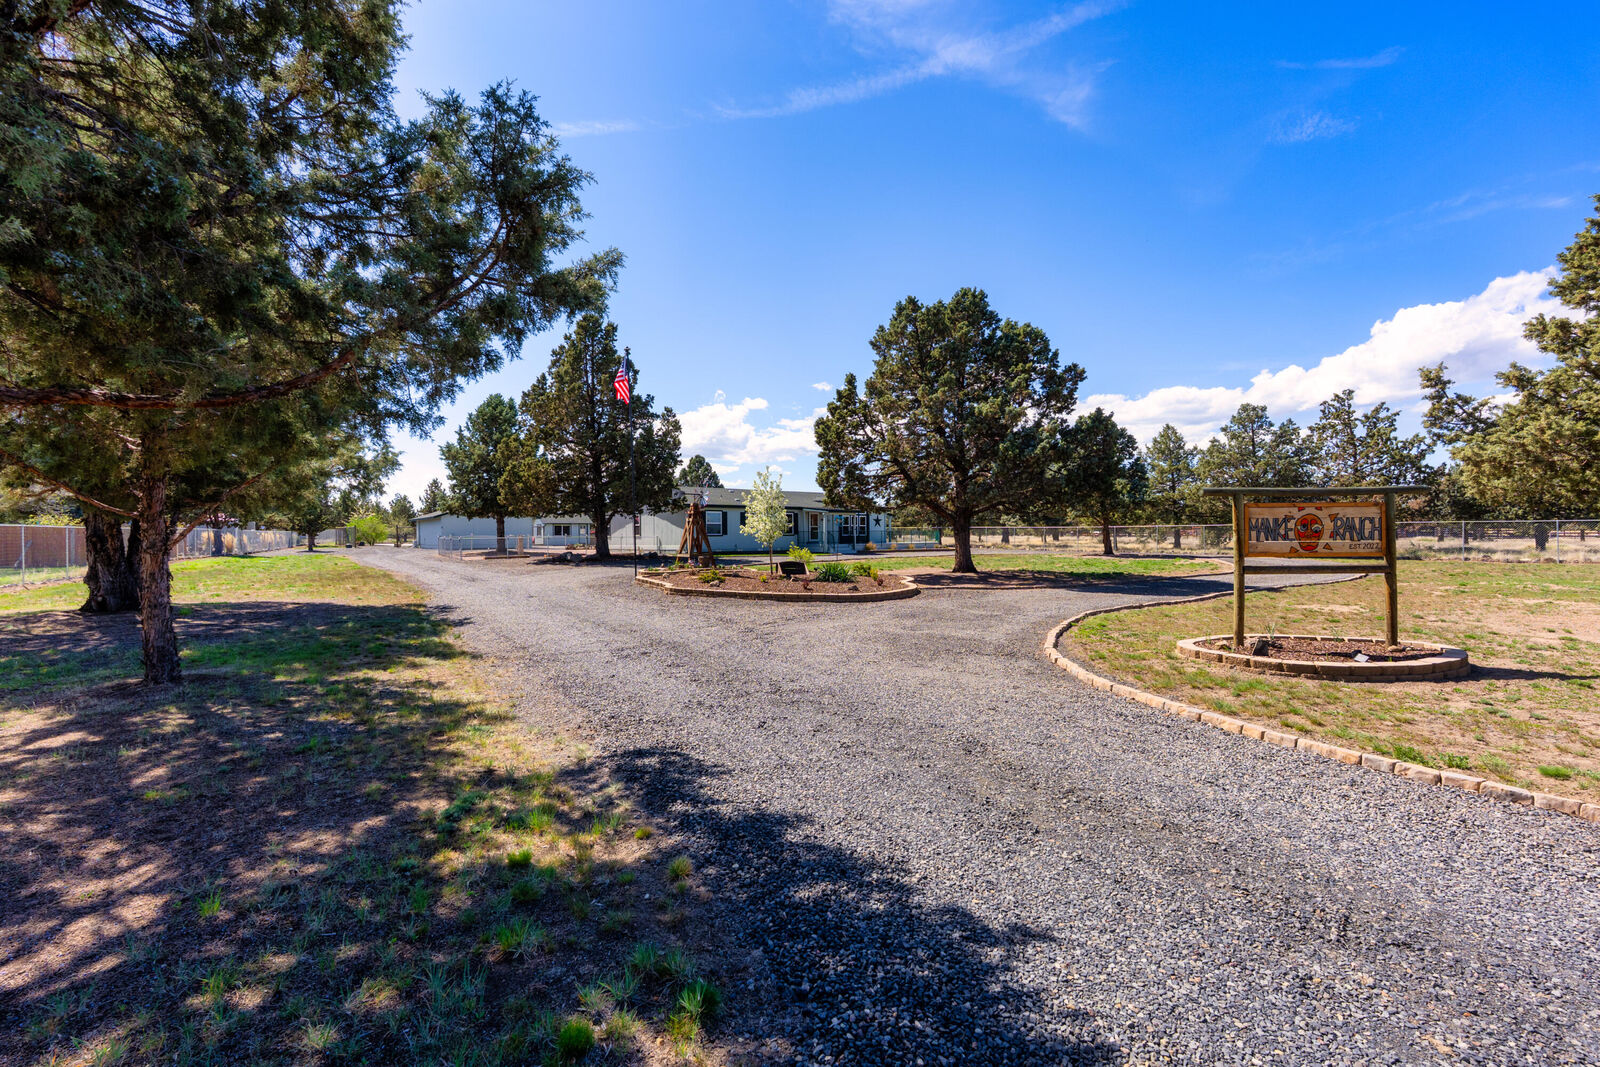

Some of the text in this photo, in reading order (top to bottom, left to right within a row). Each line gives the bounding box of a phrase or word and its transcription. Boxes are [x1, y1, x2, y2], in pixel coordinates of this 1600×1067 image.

[1248, 516, 1382, 542] MANKE RANCH
[1362, 542, 1379, 550] 2022
